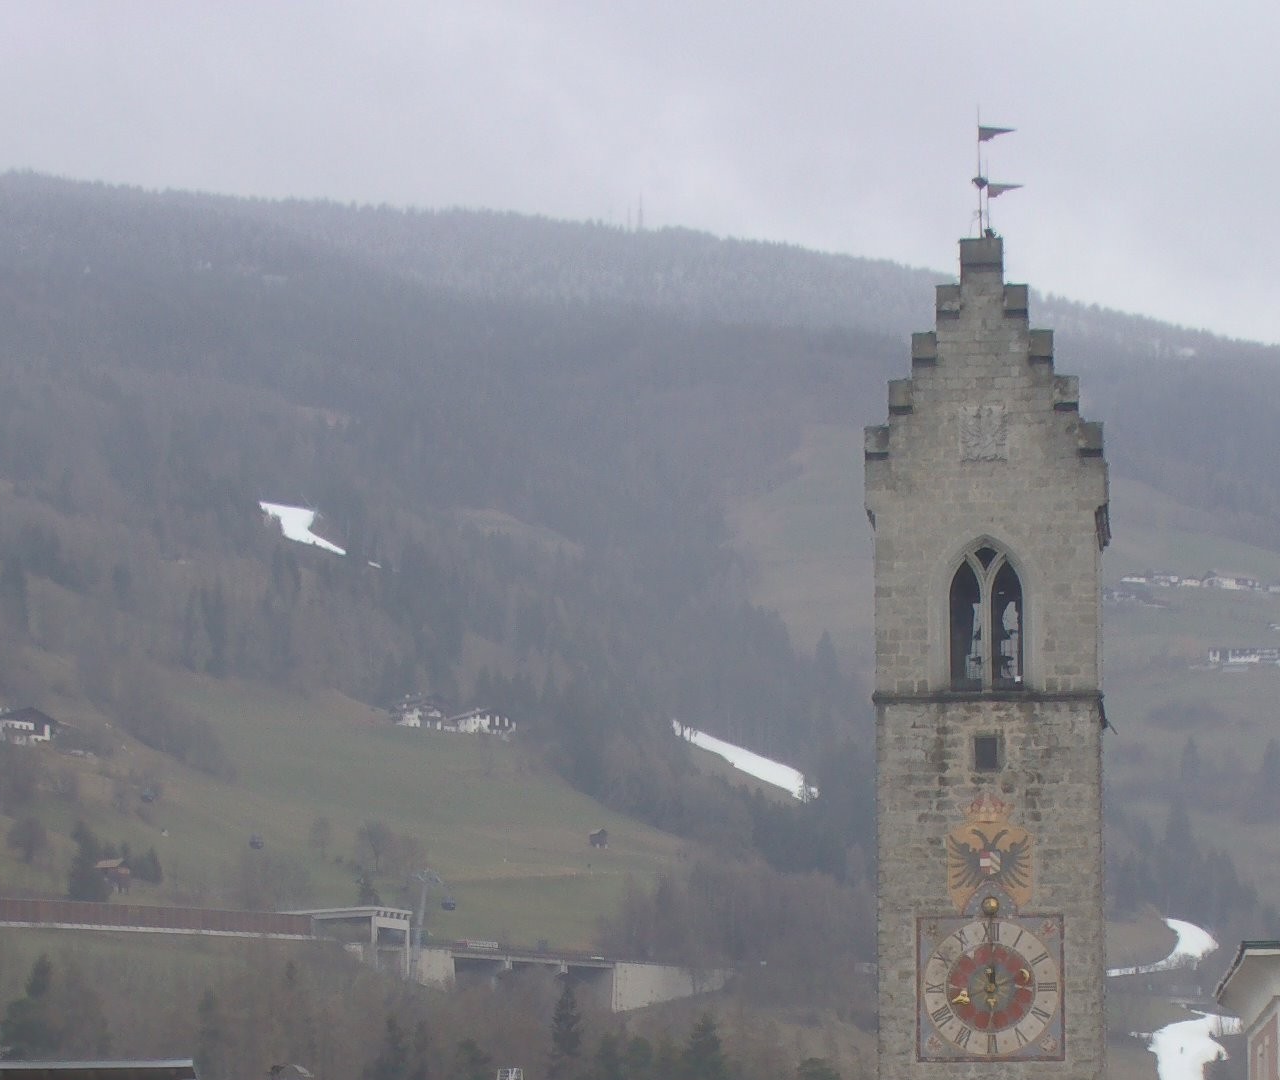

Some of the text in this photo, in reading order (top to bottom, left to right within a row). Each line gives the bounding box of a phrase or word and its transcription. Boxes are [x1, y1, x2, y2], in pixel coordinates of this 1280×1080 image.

[1013, 929, 1024, 948] I
[1029, 952, 1049, 966] II
[926, 982, 944, 994] IX
[1014, 1028, 1029, 1048] V
